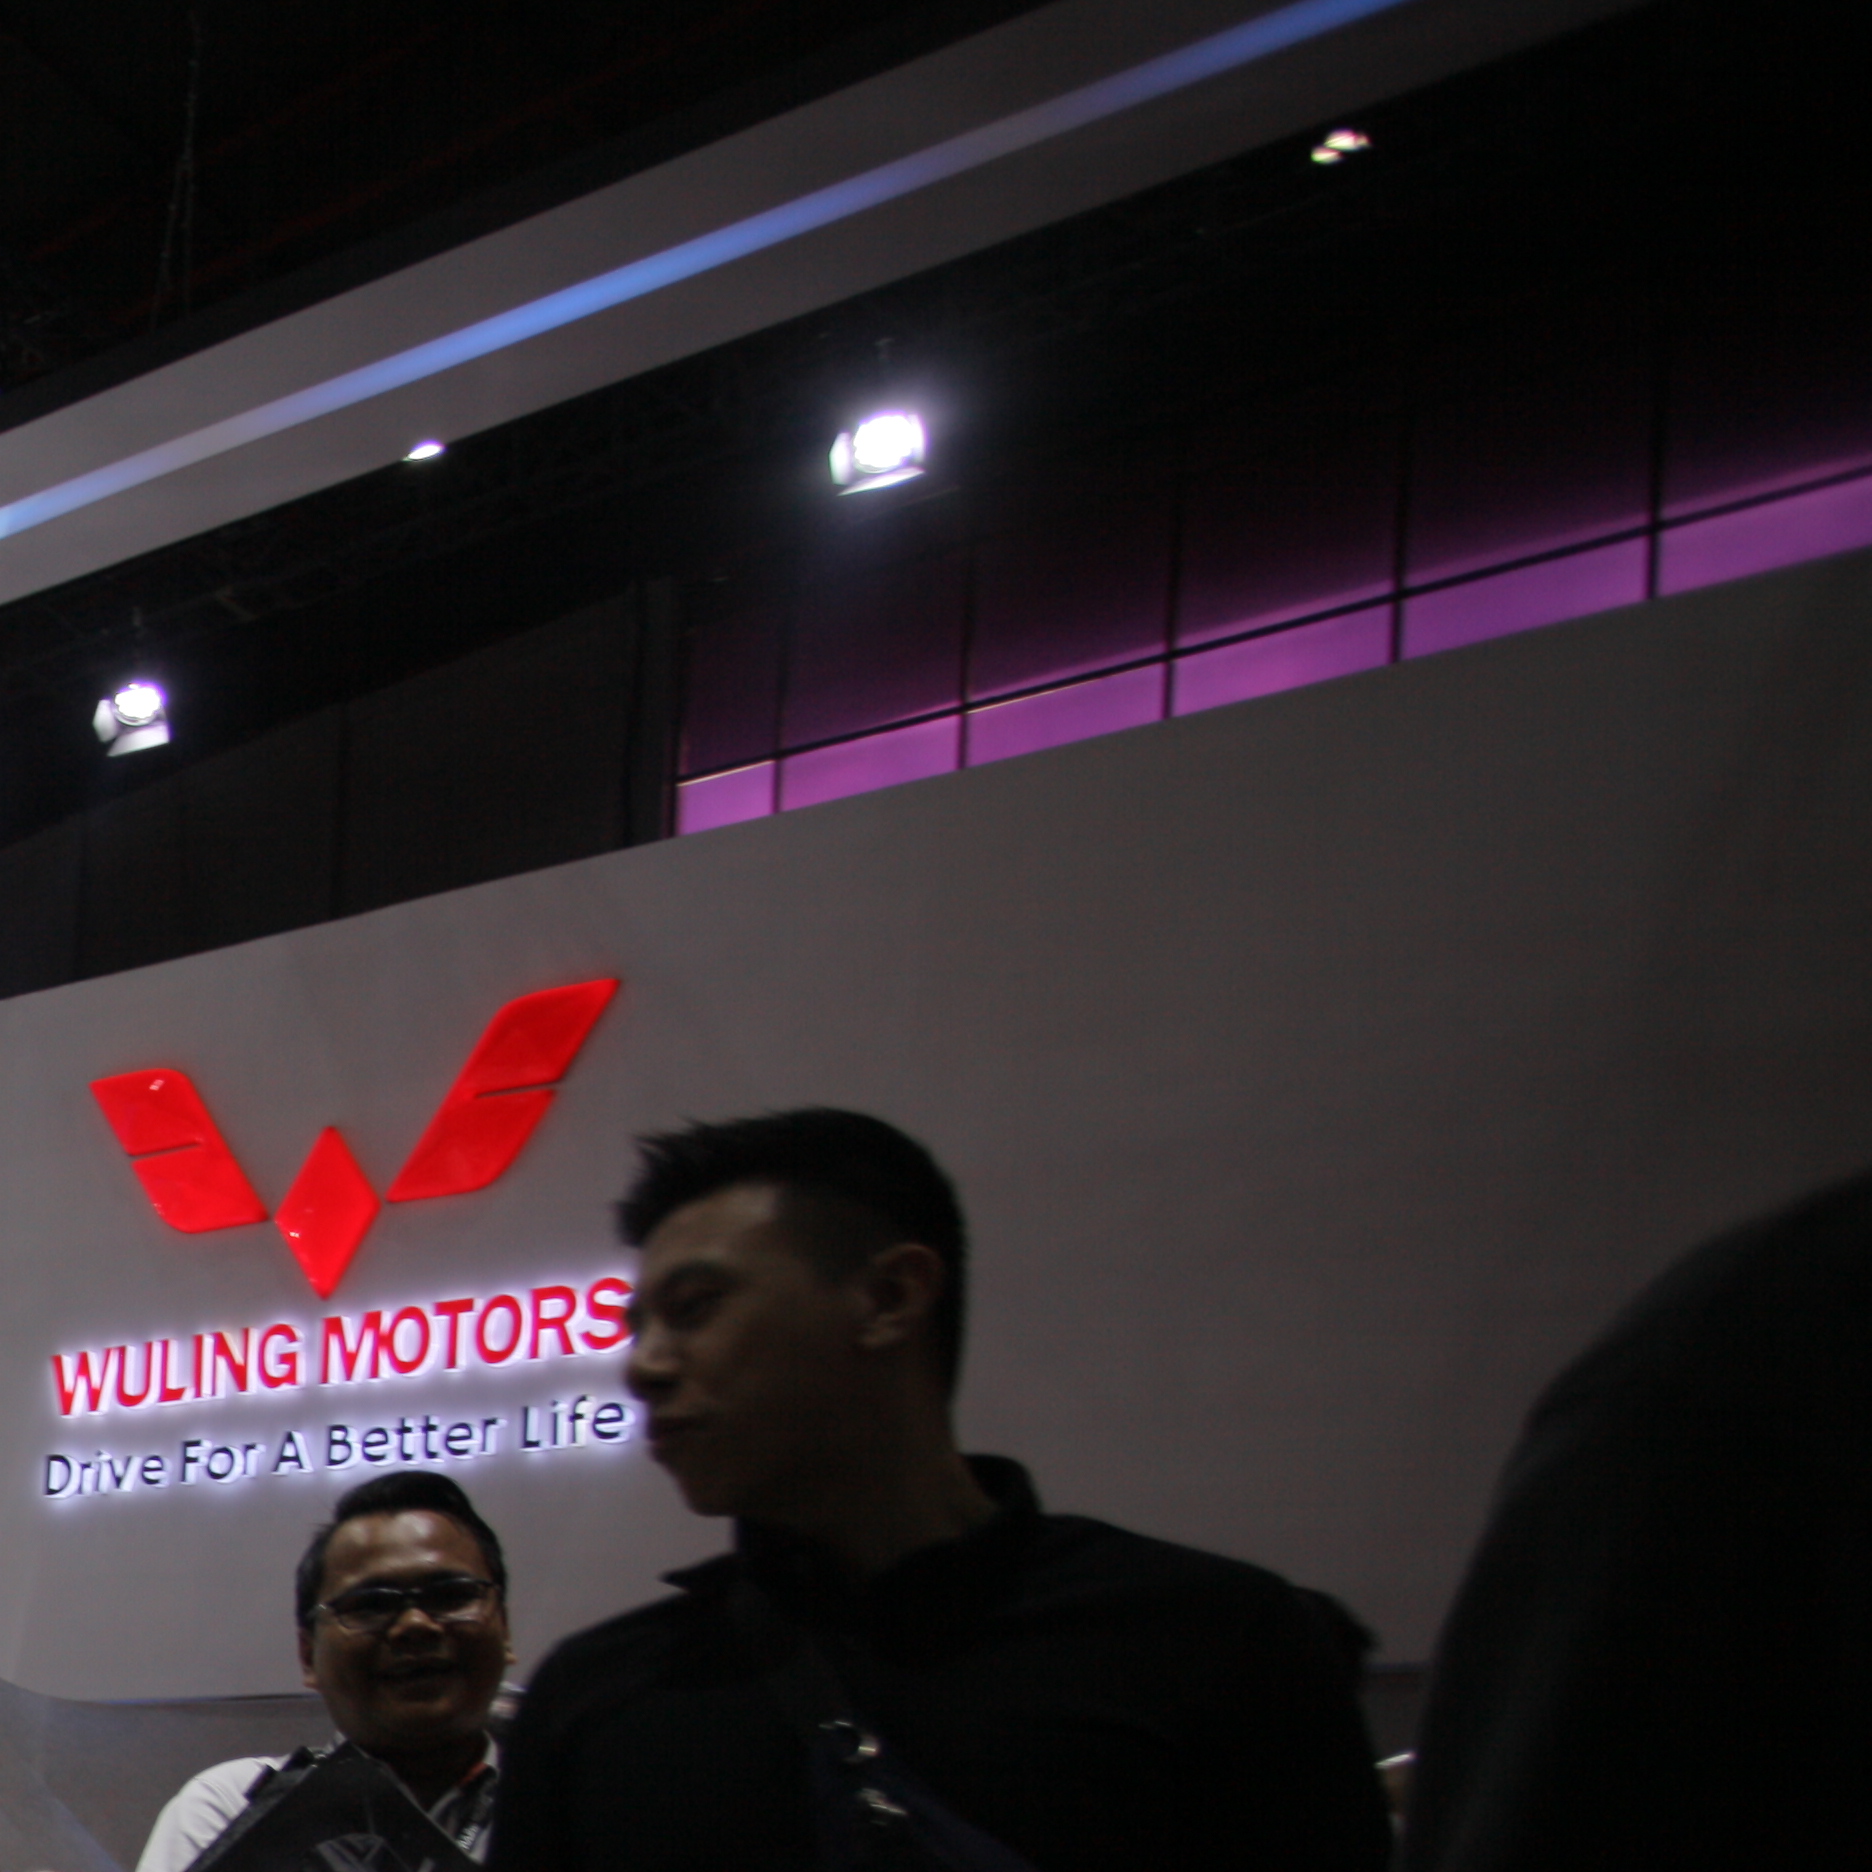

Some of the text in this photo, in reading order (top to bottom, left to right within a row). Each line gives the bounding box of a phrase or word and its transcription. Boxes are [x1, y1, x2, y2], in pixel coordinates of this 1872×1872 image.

[51, 1277, 636, 1418] WULING MOTORS
[44, 1395, 635, 1498] Drive For A Better Life
